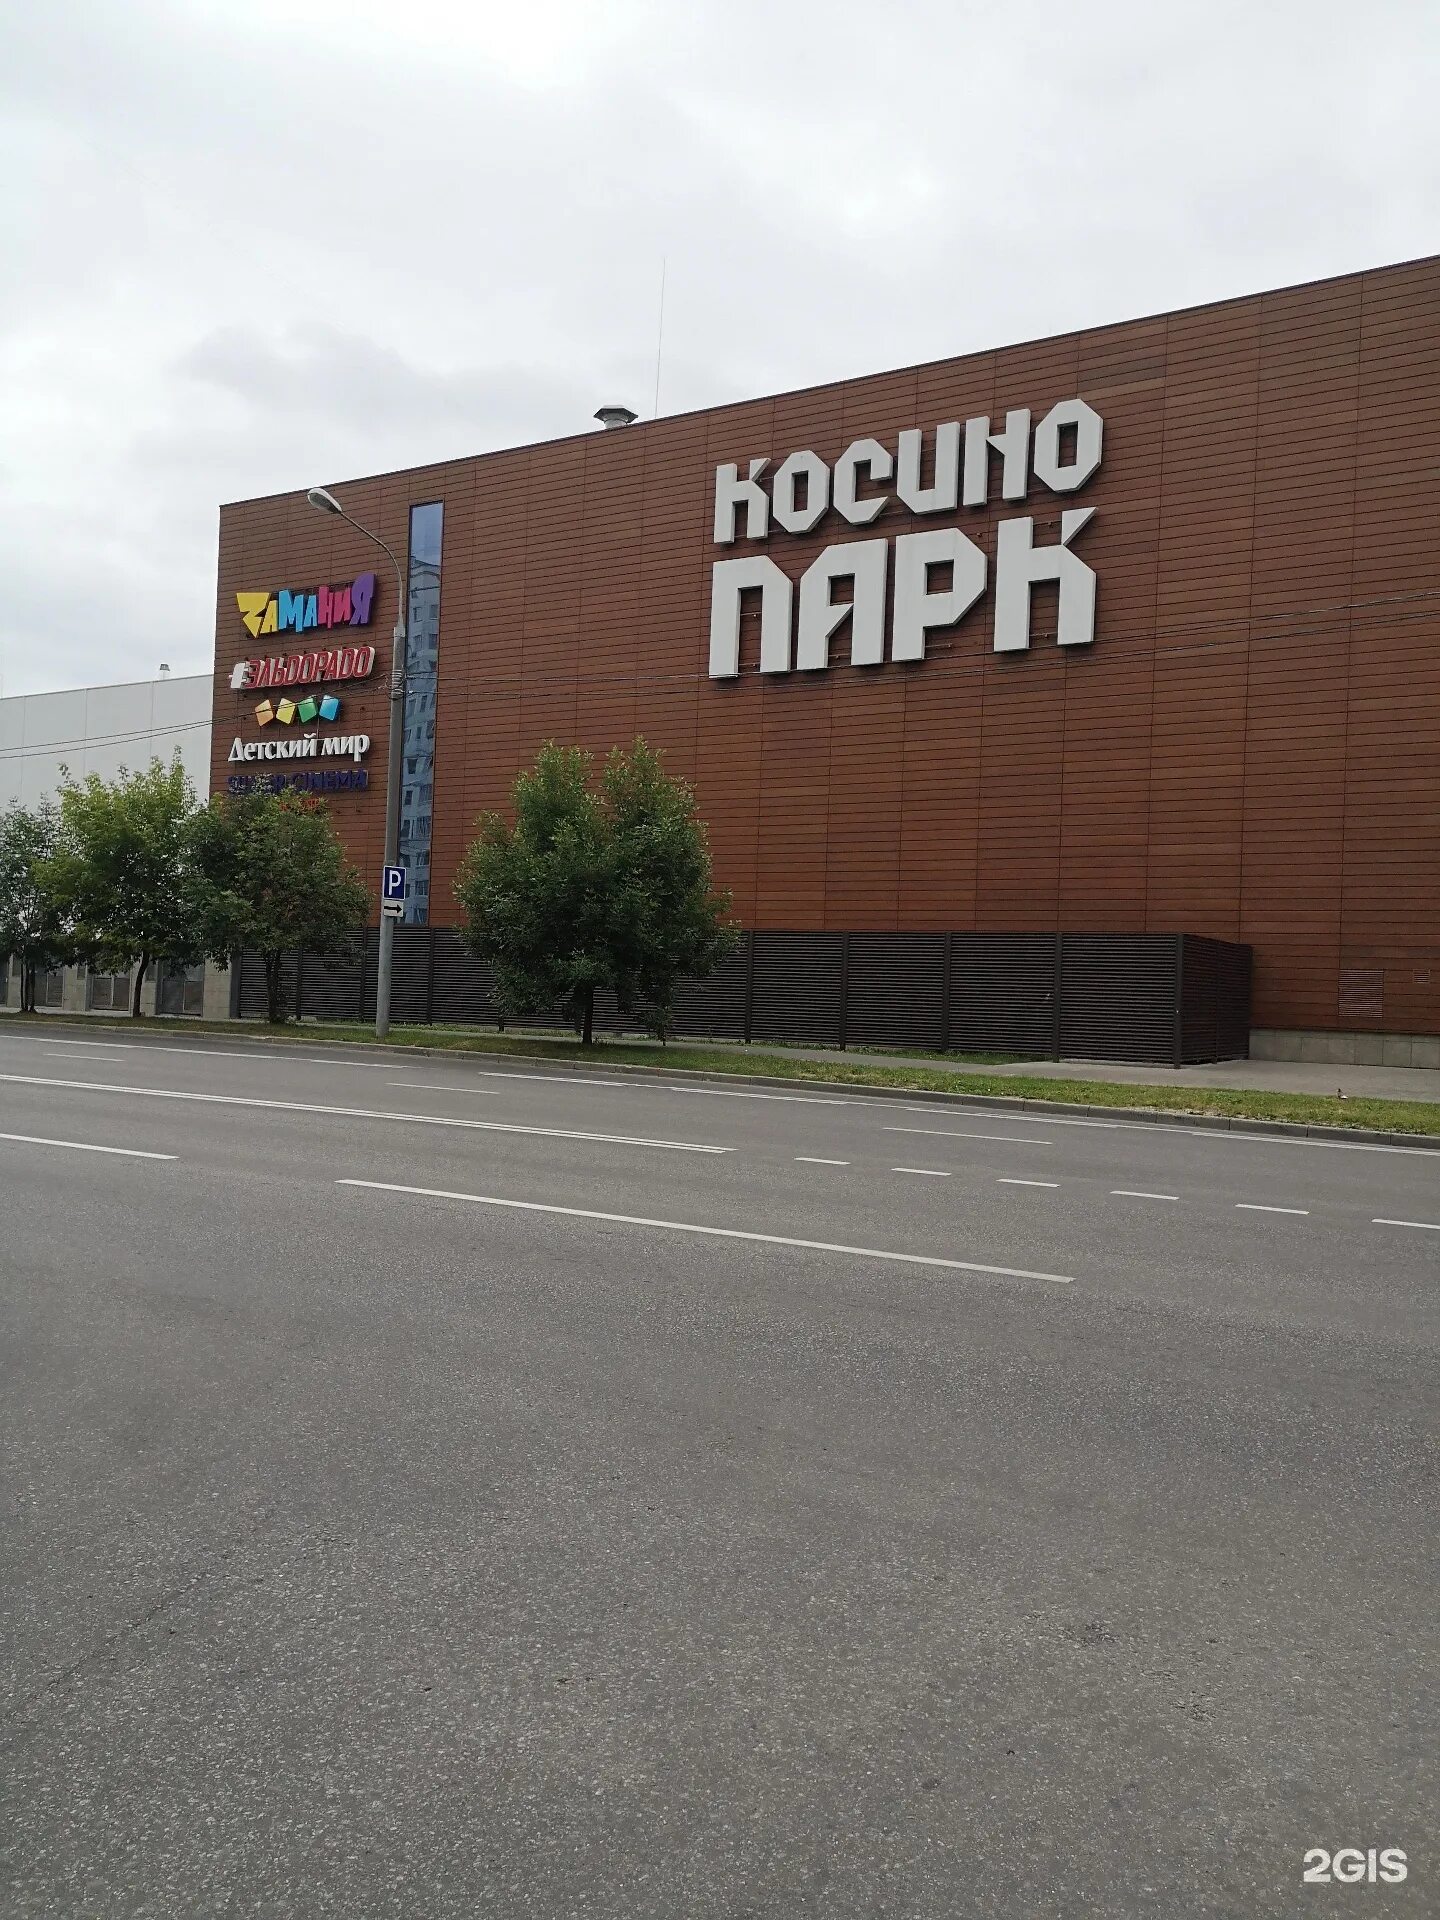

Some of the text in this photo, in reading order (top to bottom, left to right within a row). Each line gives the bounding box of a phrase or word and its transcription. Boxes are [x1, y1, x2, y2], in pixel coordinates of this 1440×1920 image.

[713, 398, 1104, 544] КОСИНО
[708, 506, 1098, 679] ПАРК
[228, 733, 370, 762] Детский мир
[388, 869, 402, 896] P
